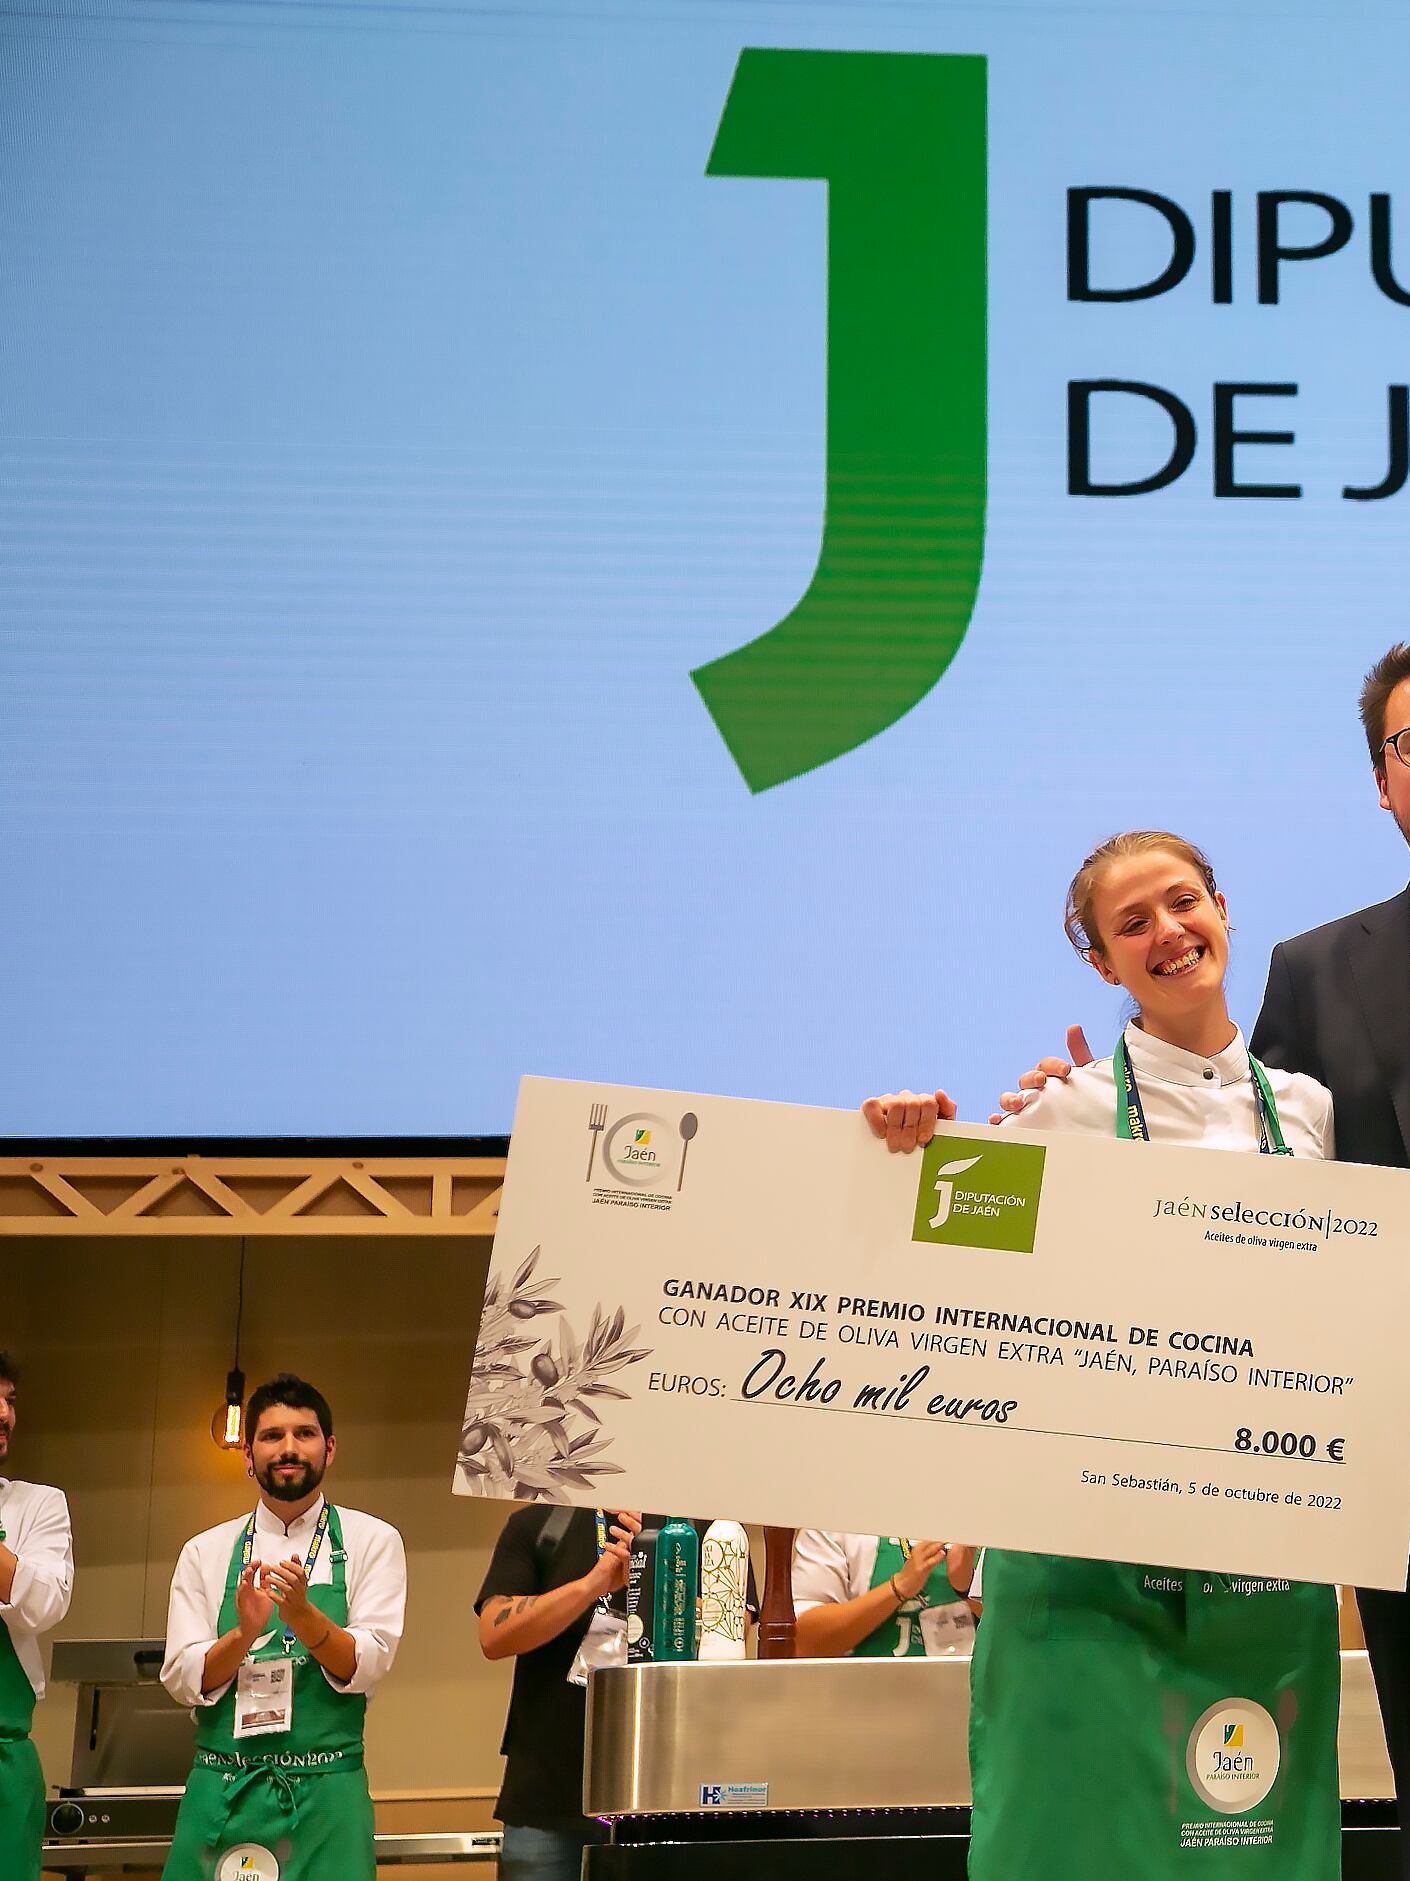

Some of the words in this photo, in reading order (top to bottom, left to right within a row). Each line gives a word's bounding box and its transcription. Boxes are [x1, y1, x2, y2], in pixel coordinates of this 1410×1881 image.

[1067, 380, 1302, 498] DE
[624, 1145, 656, 1161] Jaén
[640, 1203, 671, 1211] INTERIOR
[955, 1191, 1025, 1206] DIPUTACIÓN
[953, 1204, 969, 1214] DE
[971, 1205, 1000, 1217] JAÉN
[1204, 1230, 1234, 1243] Aceites
[1235, 1233, 1246, 1244] de
[1247, 1235, 1267, 1247] oliva
[1269, 1238, 1294, 1251] virgen
[1296, 1241, 1318, 1252] extra
[662, 1278, 780, 1309] GANADOR
[789, 1291, 827, 1312] XIX
[836, 1296, 926, 1322] PREMIO
[934, 1307, 1117, 1344] INTERNACIONAL
[1129, 1327, 1159, 1347] DE
[1169, 1331, 1254, 1357] COCINA
[659, 1306, 706, 1328] CON
[716, 1312, 789, 1336] ACEITE
[799, 1320, 828, 1340] DE
[838, 1324, 899, 1349] OLIVA
[911, 1332, 987, 1357] VIRGEN
[998, 1341, 1064, 1366] EXTRA
[1148, 1356, 1237, 1384] PARAÍSO
[648, 1372, 727, 1397] EUROS:
[740, 1349, 842, 1404] Ocho
[854, 1365, 930, 1413] mil
[927, 1392, 1018, 1424] euros
[1234, 1428, 1316, 1458] 8.000
[1327, 1437, 1346, 1461] €
[1080, 1470, 1106, 1486] San
[1112, 1473, 1183, 1495] Sebastián,
[1188, 1482, 1196, 1495] 5
[1201, 1481, 1219, 1497] de
[1224, 1484, 1280, 1504] octubre
[1284, 1490, 1302, 1506] de
[1307, 1494, 1342, 1510] 2022
[1144, 1575, 1183, 1591] Aceites
[1231, 1579, 1264, 1596] virgen
[1213, 1751, 1253, 1772] Jaén
[1206, 1771, 1231, 1780] PARAÍSO
[1204, 1821, 1248, 1829] INTERNACIONAL
[1180, 1837, 1202, 1848] JAÉN
[1204, 1836, 1239, 1847] PARAÍSO
[1241, 1835, 1273, 1845] INTERIOR
